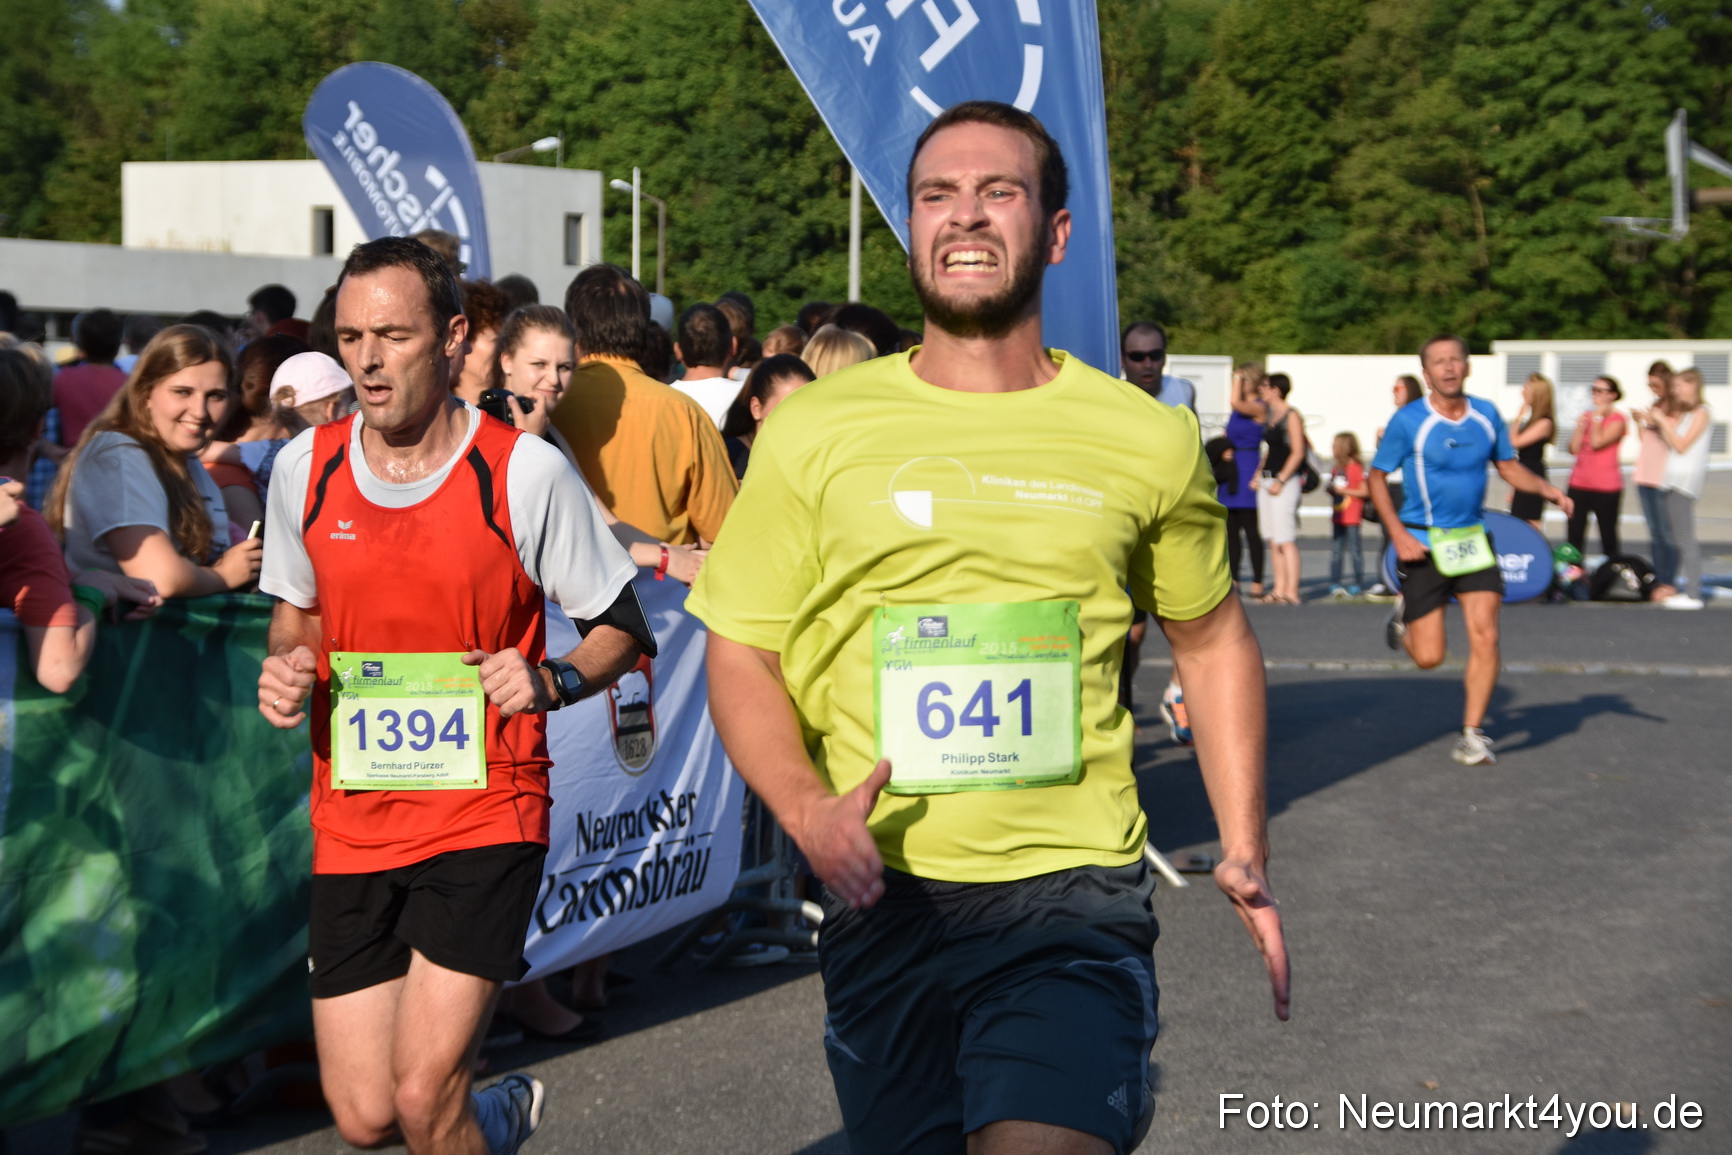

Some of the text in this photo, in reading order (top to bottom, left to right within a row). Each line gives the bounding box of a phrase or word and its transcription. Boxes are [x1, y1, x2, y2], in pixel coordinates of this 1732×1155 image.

[981, 475, 1026, 488] Kliniken
[1029, 480, 1047, 489] des
[1015, 490, 1068, 503] Neumarkt
[330, 531, 356, 540] erima
[904, 635, 977, 649] firmenlauf
[979, 642, 1017, 655] 2015
[353, 676, 404, 686] firmenlauf
[405, 682, 433, 691] 2015
[917, 678, 1032, 739] 641
[349, 708, 469, 752] 1394
[624, 737, 647, 760] 1628
[370, 761, 444, 770] Bernhard Pürzer
[942, 752, 1020, 766] Philipp Stark
